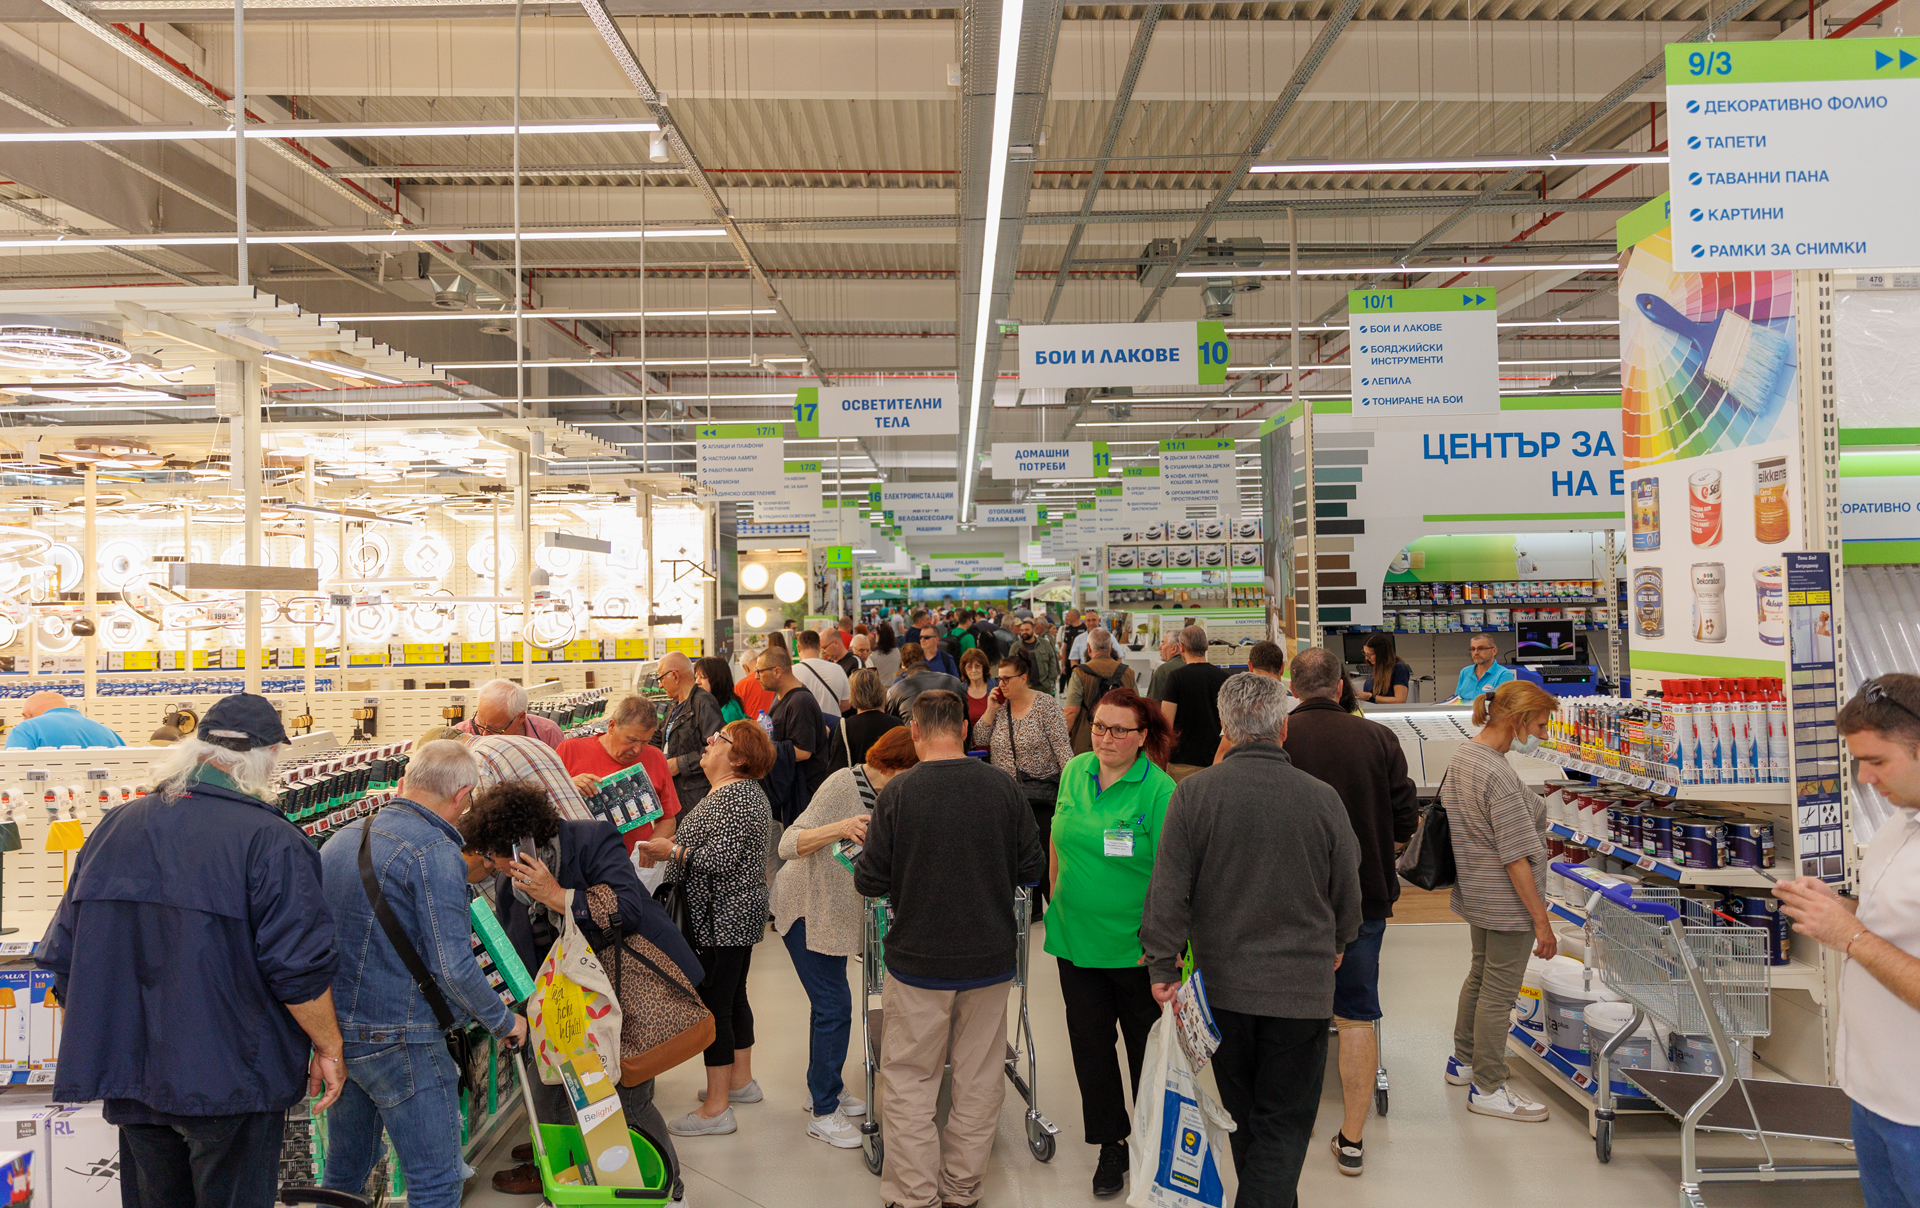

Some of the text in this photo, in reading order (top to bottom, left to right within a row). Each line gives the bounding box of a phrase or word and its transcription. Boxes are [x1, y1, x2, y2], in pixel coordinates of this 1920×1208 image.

[1688, 51, 1732, 76] 9/3
[1704, 96, 1888, 115] ДЕКОРАТИВНО ФОЛИО
[1705, 135, 1767, 149] ТАПЕТИ
[1706, 170, 1830, 185] ТАВАННИ ПАНА
[1708, 207, 1784, 221] КАРТИНИ
[1709, 241, 1867, 257] РАМКИ ЗА СНИМКИ
[1362, 295, 1393, 309] 10/1
[1370, 323, 1442, 333] БОИ И ЛАКОВЕ
[1199, 341, 1228, 365] 10
[1370, 342, 1443, 354] БОЯДЖИЙСКИ
[1035, 348, 1180, 365] БОИ И ЛАКОВЕ
[1371, 356, 1443, 365] ИНСТРУМЕНТИ
[1371, 377, 1411, 385] ЛЕПИЛА
[841, 398, 942, 411] ОСВЕТИТЕЛНИ
[1372, 395, 1463, 405] ТОНИРАНЕ НА БОИ
[793, 403, 818, 422] 17
[875, 417, 910, 428] ТЕЛА
[756, 427, 776, 436] 17/1
[1166, 442, 1185, 450] 11/1
[1423, 431, 1616, 464] ЦЕНТЪР ЗА
[1015, 449, 1069, 460] ДОМАШНИ
[1094, 453, 1109, 466] 11
[1019, 462, 1066, 471] ПОТРЕБИ
[1758, 469, 1786, 483] sikkens
[1552, 471, 1598, 496] НА
[868, 492, 881, 502] 16
[884, 492, 954, 500] ЕЛЕКТРОИНСТАЛАЦИИ
[882, 511, 894, 519] 15
[1038, 511, 1047, 519] 12
[36, 1074, 46, 1082] 59
[584, 1103, 613, 1123] Belight
[54, 1121, 75, 1135] RL
